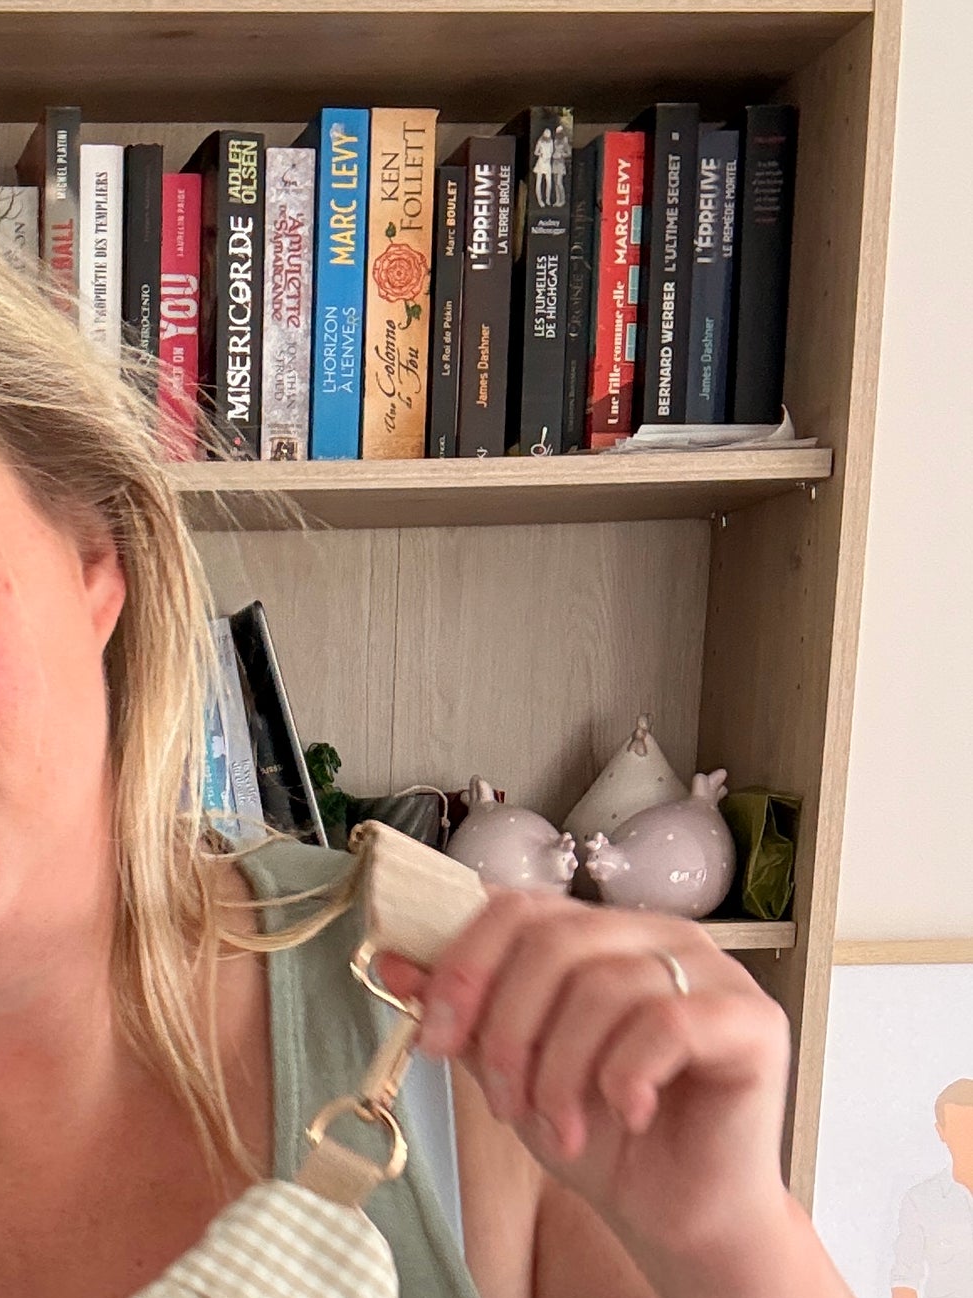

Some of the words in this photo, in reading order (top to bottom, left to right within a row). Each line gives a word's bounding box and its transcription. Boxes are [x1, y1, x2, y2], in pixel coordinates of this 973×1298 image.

[56, 164, 68, 200] MICHEL
[228, 139, 242, 199] ADLER
[241, 140, 258, 205] OLSEN
[331, 133, 359, 189] LEVY
[380, 151, 400, 202] KEN
[399, 120, 426, 232] FOLLETT
[498, 164, 511, 205] BRÛLÉE
[616, 158, 632, 206] LEVY
[666, 153, 682, 205] SECRET
[724, 158, 738, 200] MORTEL
[94, 171, 109, 234] TEMPLIERS
[446, 179, 458, 226] BOULET
[467, 163, 494, 271] L'ÉPREUVE
[497, 206, 510, 240] TERRE
[693, 157, 719, 265] L'ÉPREUVE
[721, 200, 736, 245] REMÈDE
[94, 238, 108, 258] DES
[329, 198, 357, 266] MARC
[445, 228, 456, 257] Marc
[497, 240, 509, 255] LA
[613, 210, 629, 265] MARC
[663, 205, 680, 273] L'ULTIME
[721, 244, 734, 259] LE
[91, 261, 108, 324] PROPHÉTIE
[160, 273, 199, 340] YOU
[534, 255, 548, 315] JUMELLES
[546, 254, 559, 320] HIGHGATE
[612, 280, 626, 309] elle
[226, 215, 254, 423] MISERICORDE
[442, 300, 453, 329] Pékin
[533, 316, 545, 338] LES
[545, 322, 557, 339] DE
[612, 308, 625, 363] comme
[660, 281, 677, 344] WERBER
[322, 306, 339, 394] L'HORIZON
[340, 306, 360, 378] L'ENVERS
[374, 319, 397, 398] Colonne
[442, 331, 452, 344] de
[442, 344, 452, 361] Roi
[477, 323, 491, 370] Dashner
[700, 317, 715, 363] Dashner
[273, 350, 286, 402] STROUD
[285, 340, 298, 410] JONATHAN
[338, 383, 354, 394] À
[441, 364, 451, 377] Le
[476, 372, 489, 409] James
[607, 364, 622, 395] fille
[657, 346, 674, 417] BERNARD
[699, 365, 713, 402] James
[607, 395, 620, 425] Une
